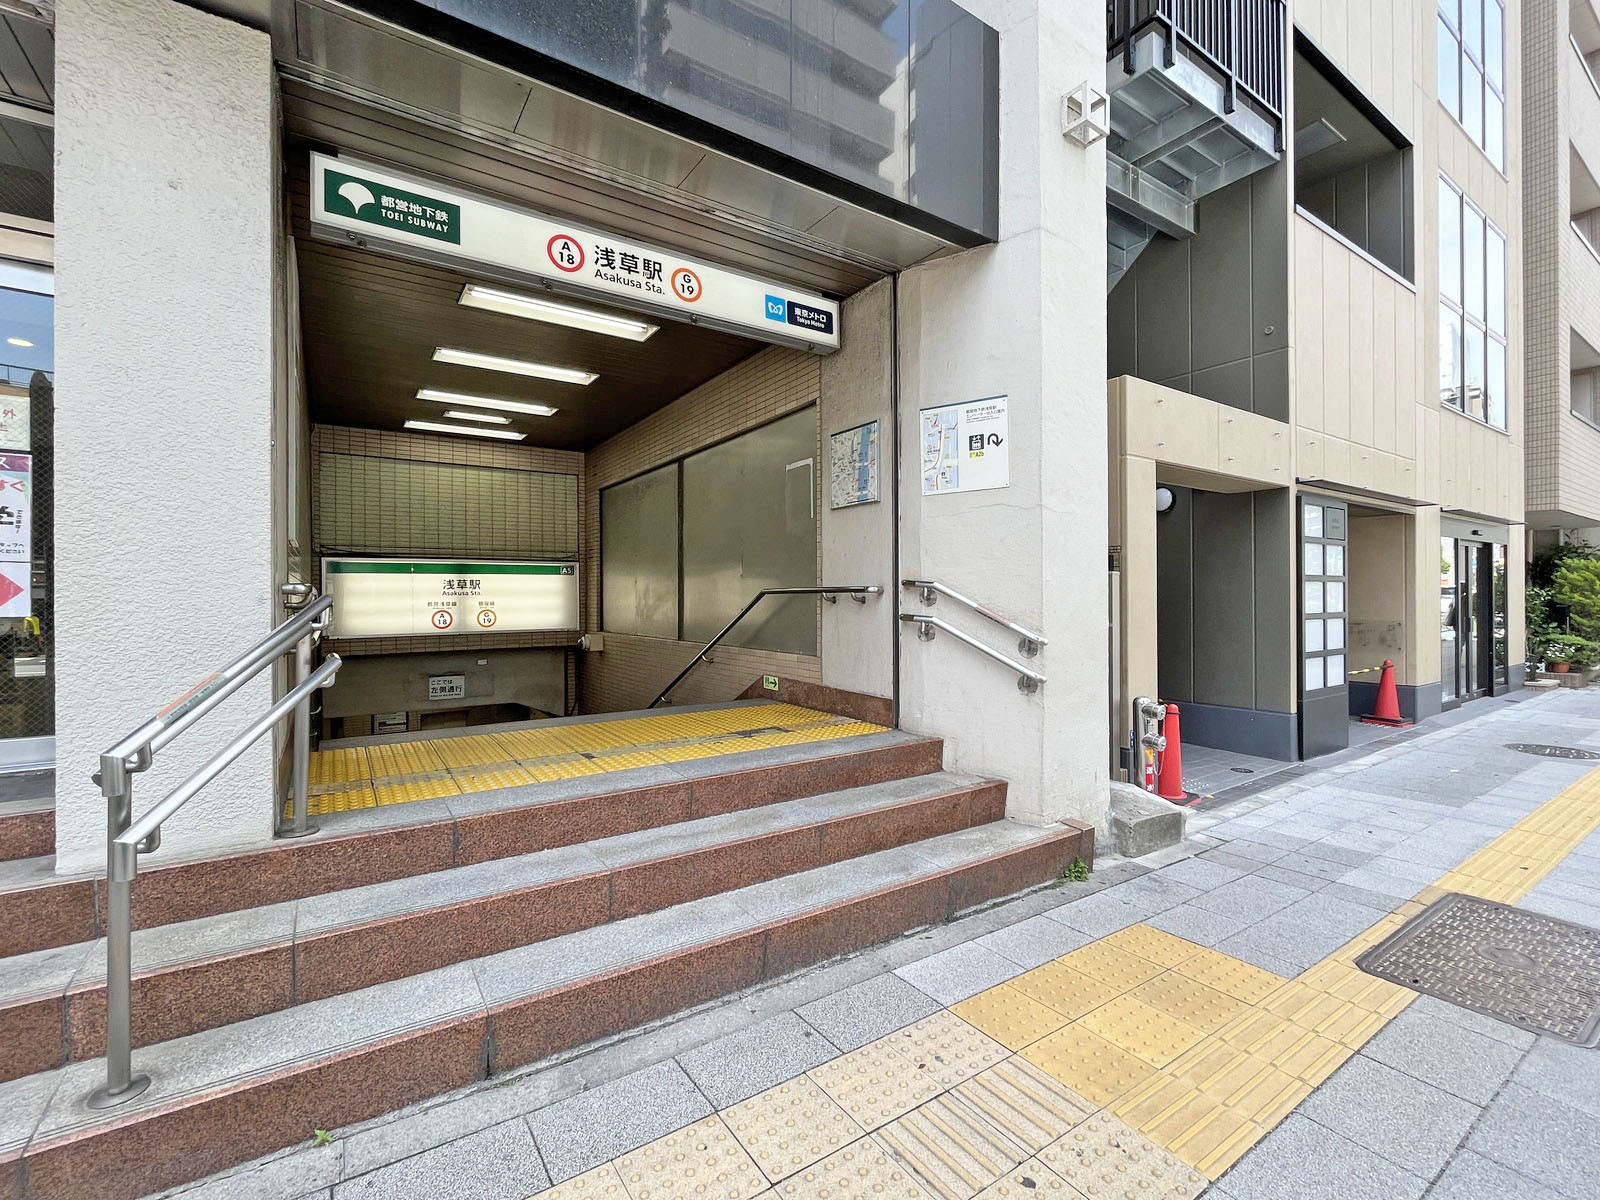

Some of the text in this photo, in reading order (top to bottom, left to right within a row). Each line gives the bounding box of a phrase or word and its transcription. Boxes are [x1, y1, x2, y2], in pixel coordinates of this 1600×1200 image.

[380, 195, 449, 222] 都営地下鉄
[380, 208, 449, 233] TOEI SUBWAY
[561, 241, 571, 252] A
[559, 252, 575, 266] 18
[594, 244, 663, 282] 浅草駅
[594, 268, 665, 296] Asakusa Sta.
[682, 273, 692, 284] G
[680, 284, 694, 296] 19
[794, 307, 827, 323] 東京メトロ
[796, 316, 825, 329] Tokyo Metro
[442, 579, 481, 590] 浅草駅
